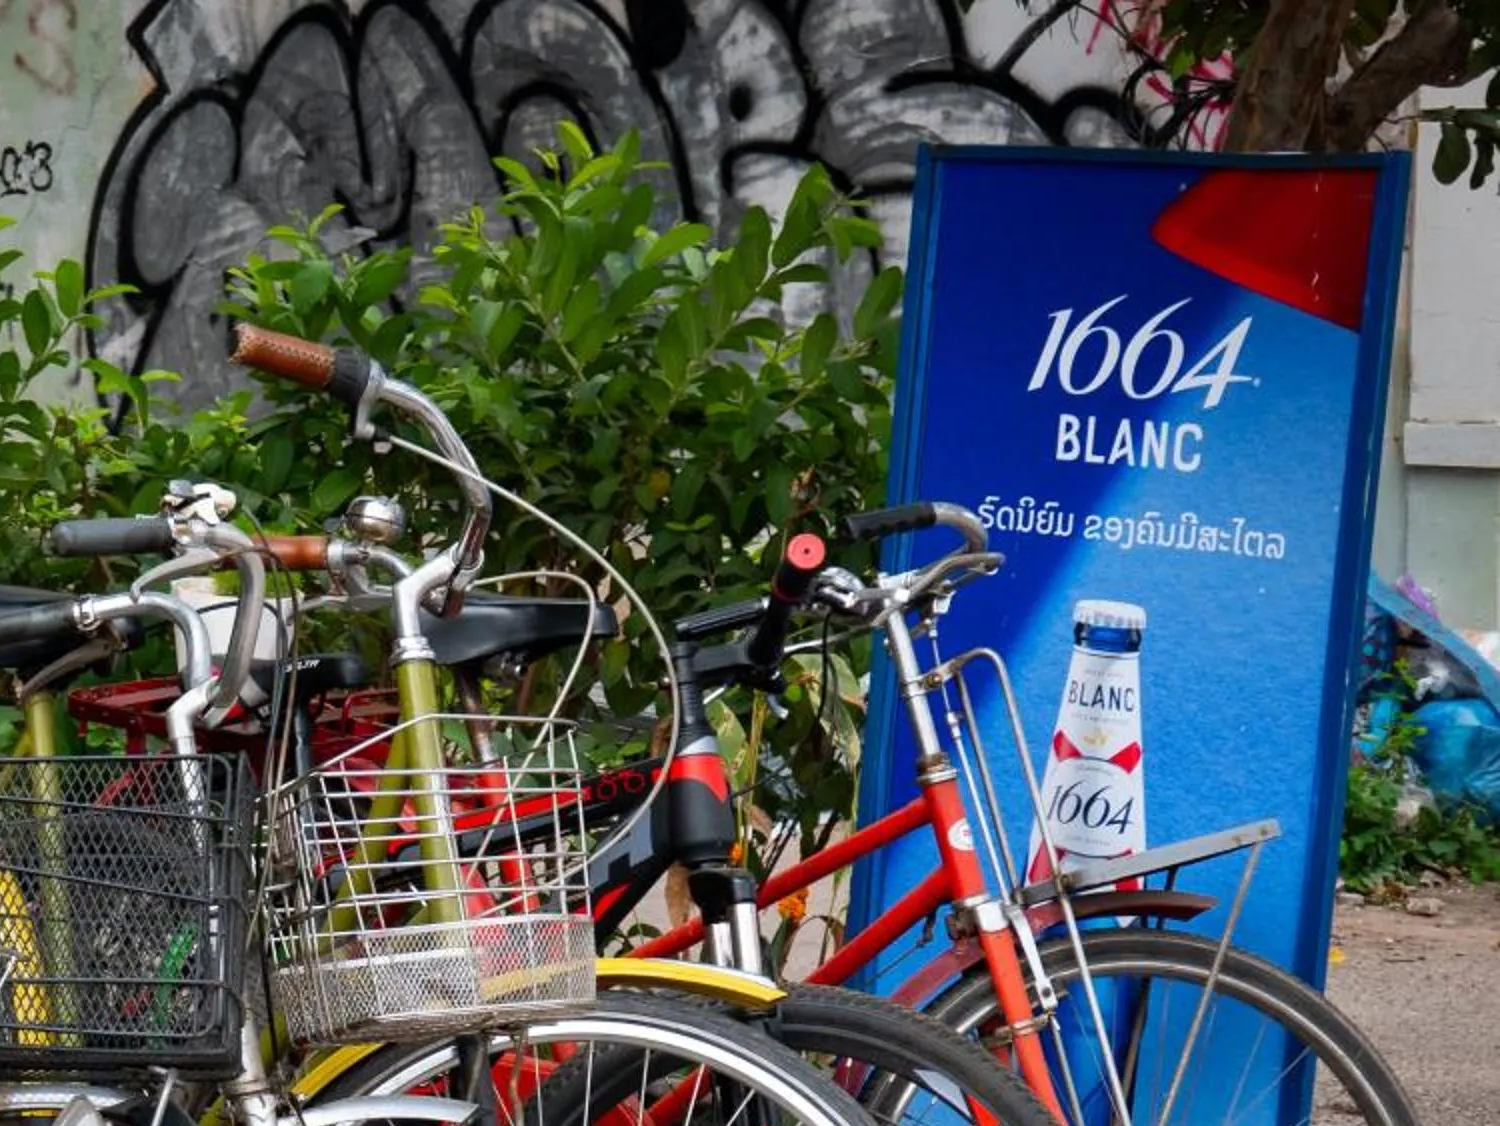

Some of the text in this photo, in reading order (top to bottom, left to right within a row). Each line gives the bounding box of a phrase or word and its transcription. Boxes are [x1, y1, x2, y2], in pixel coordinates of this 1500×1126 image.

[1027, 293, 1253, 410] 1664
[1055, 413, 1204, 473] BLANC
[1068, 680, 1135, 712] BLANC
[1046, 779, 1135, 835] 1664
